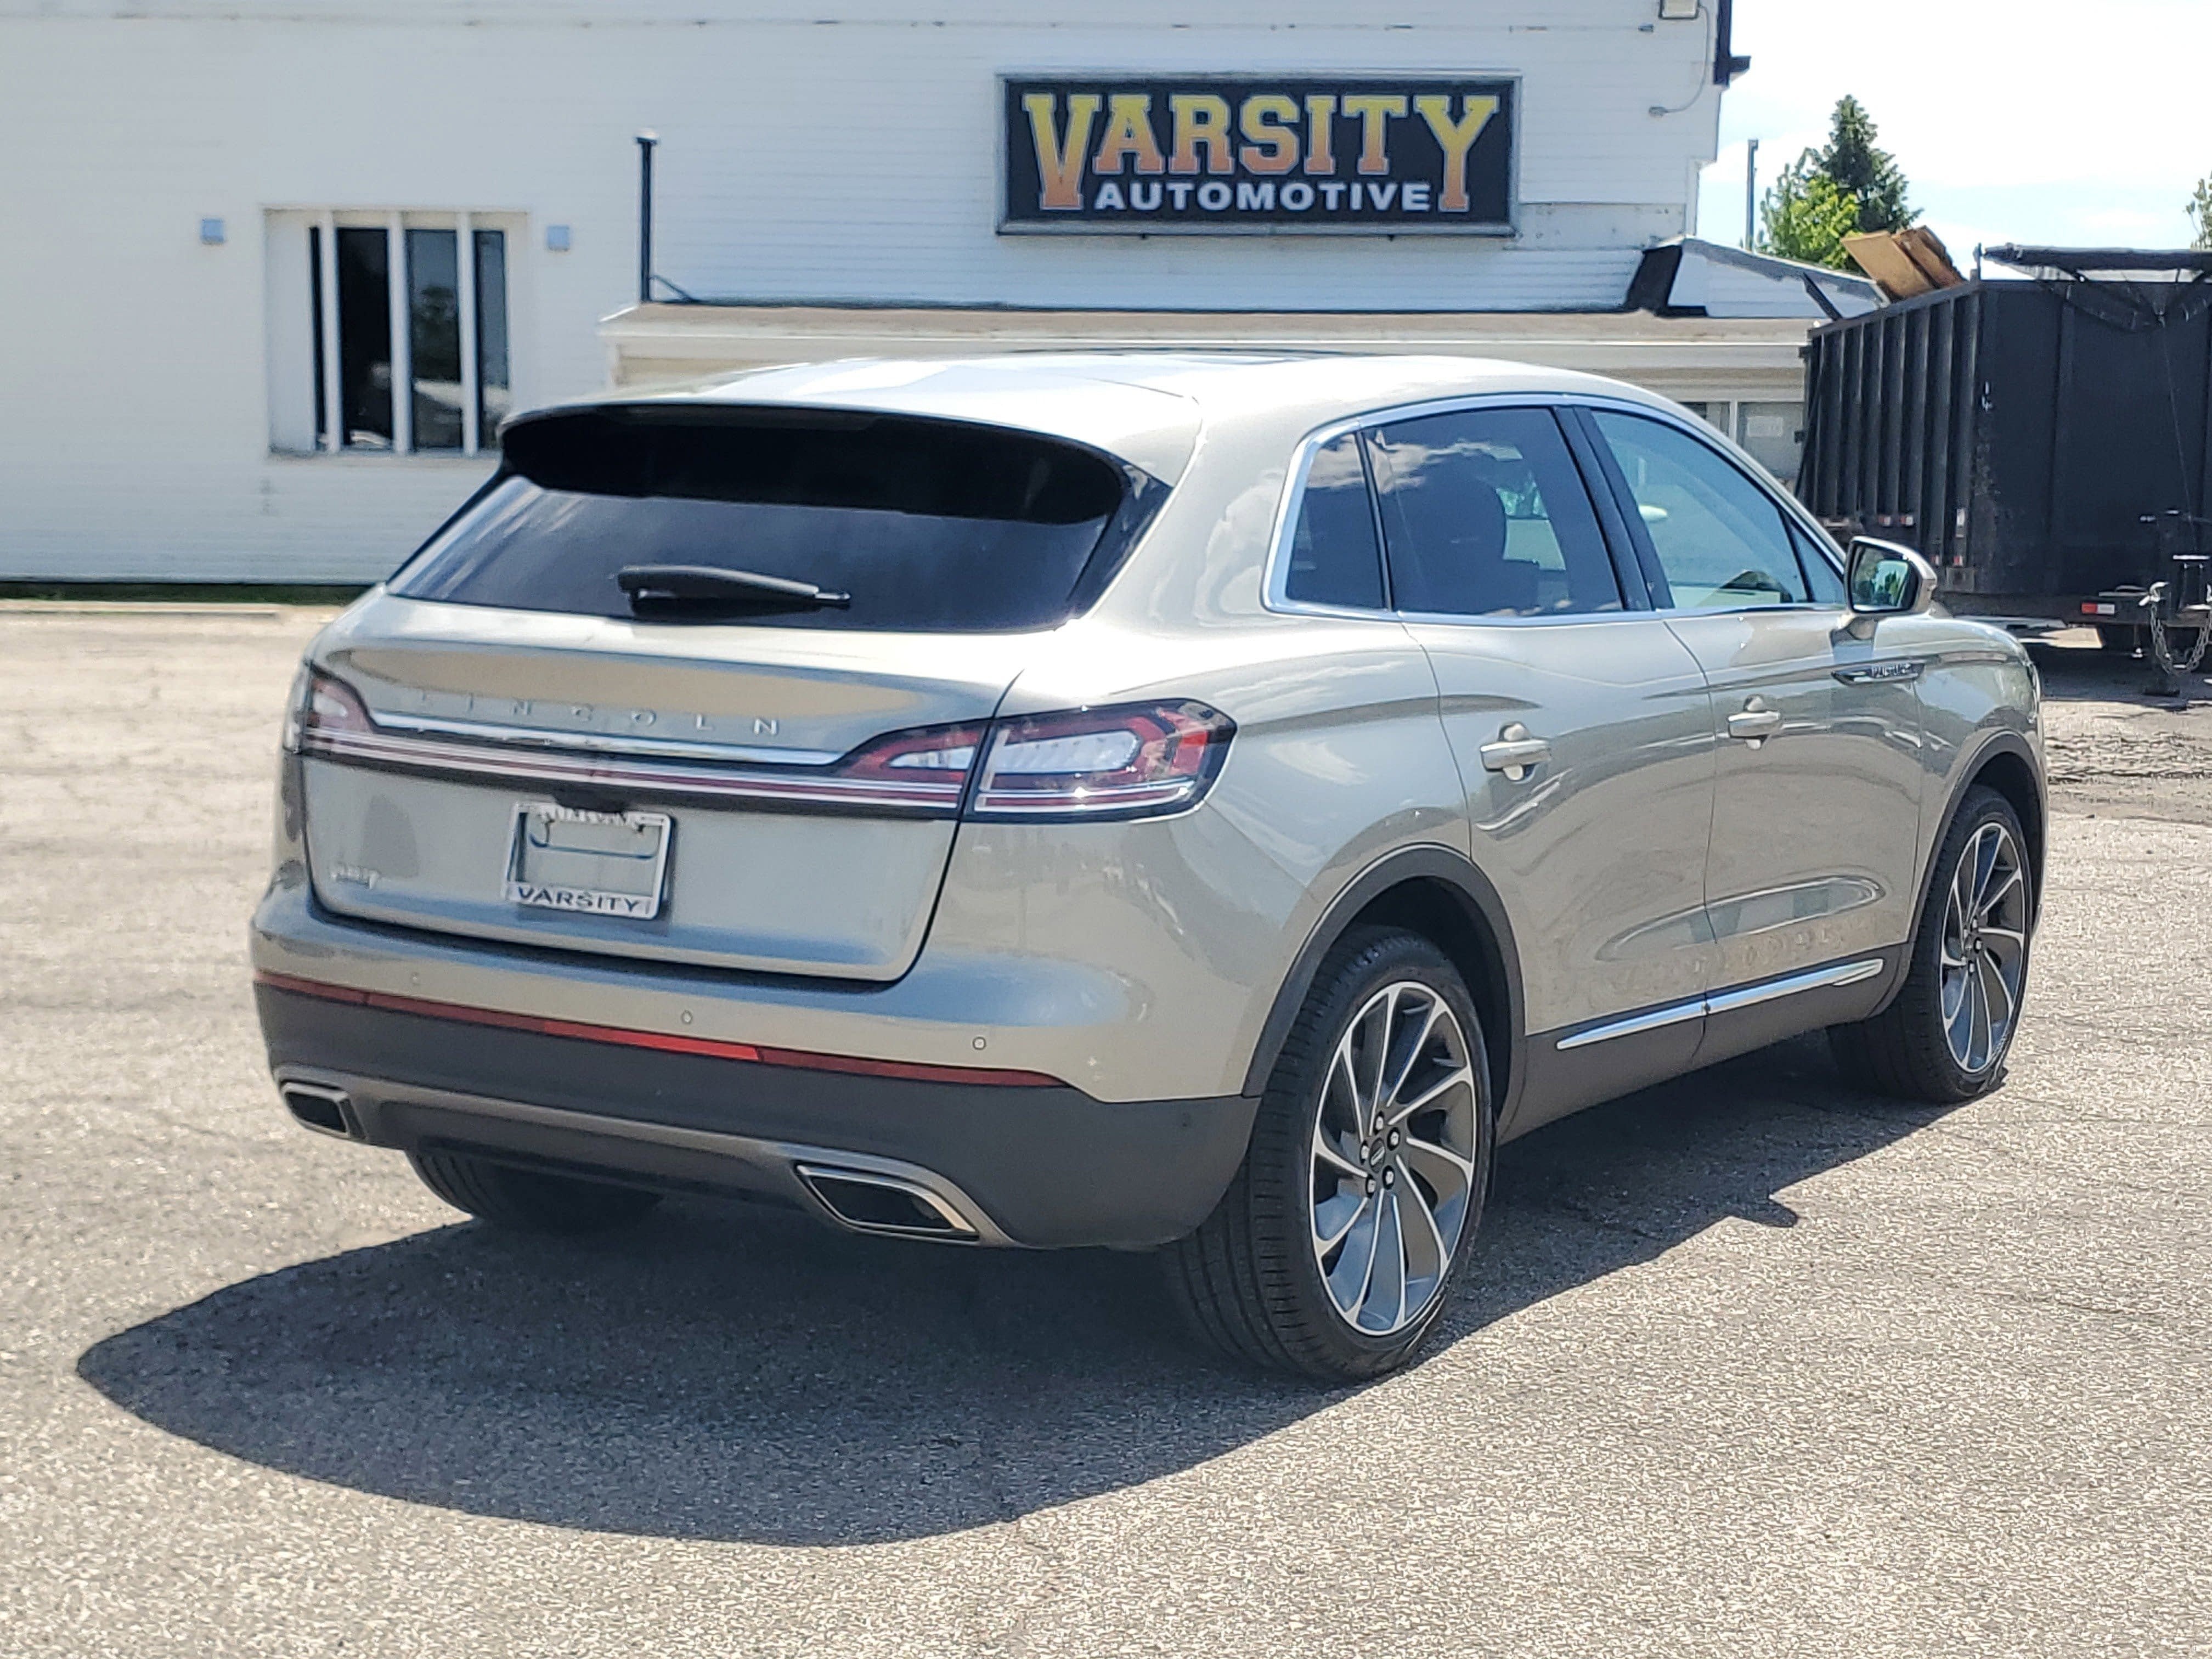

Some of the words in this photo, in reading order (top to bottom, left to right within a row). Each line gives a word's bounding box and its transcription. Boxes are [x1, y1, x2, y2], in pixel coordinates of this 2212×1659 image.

[1022, 93, 1499, 212] VARSITY
[1097, 182, 1431, 211] AUTOMOTIVE
[518, 885, 641, 912] VARSITY
